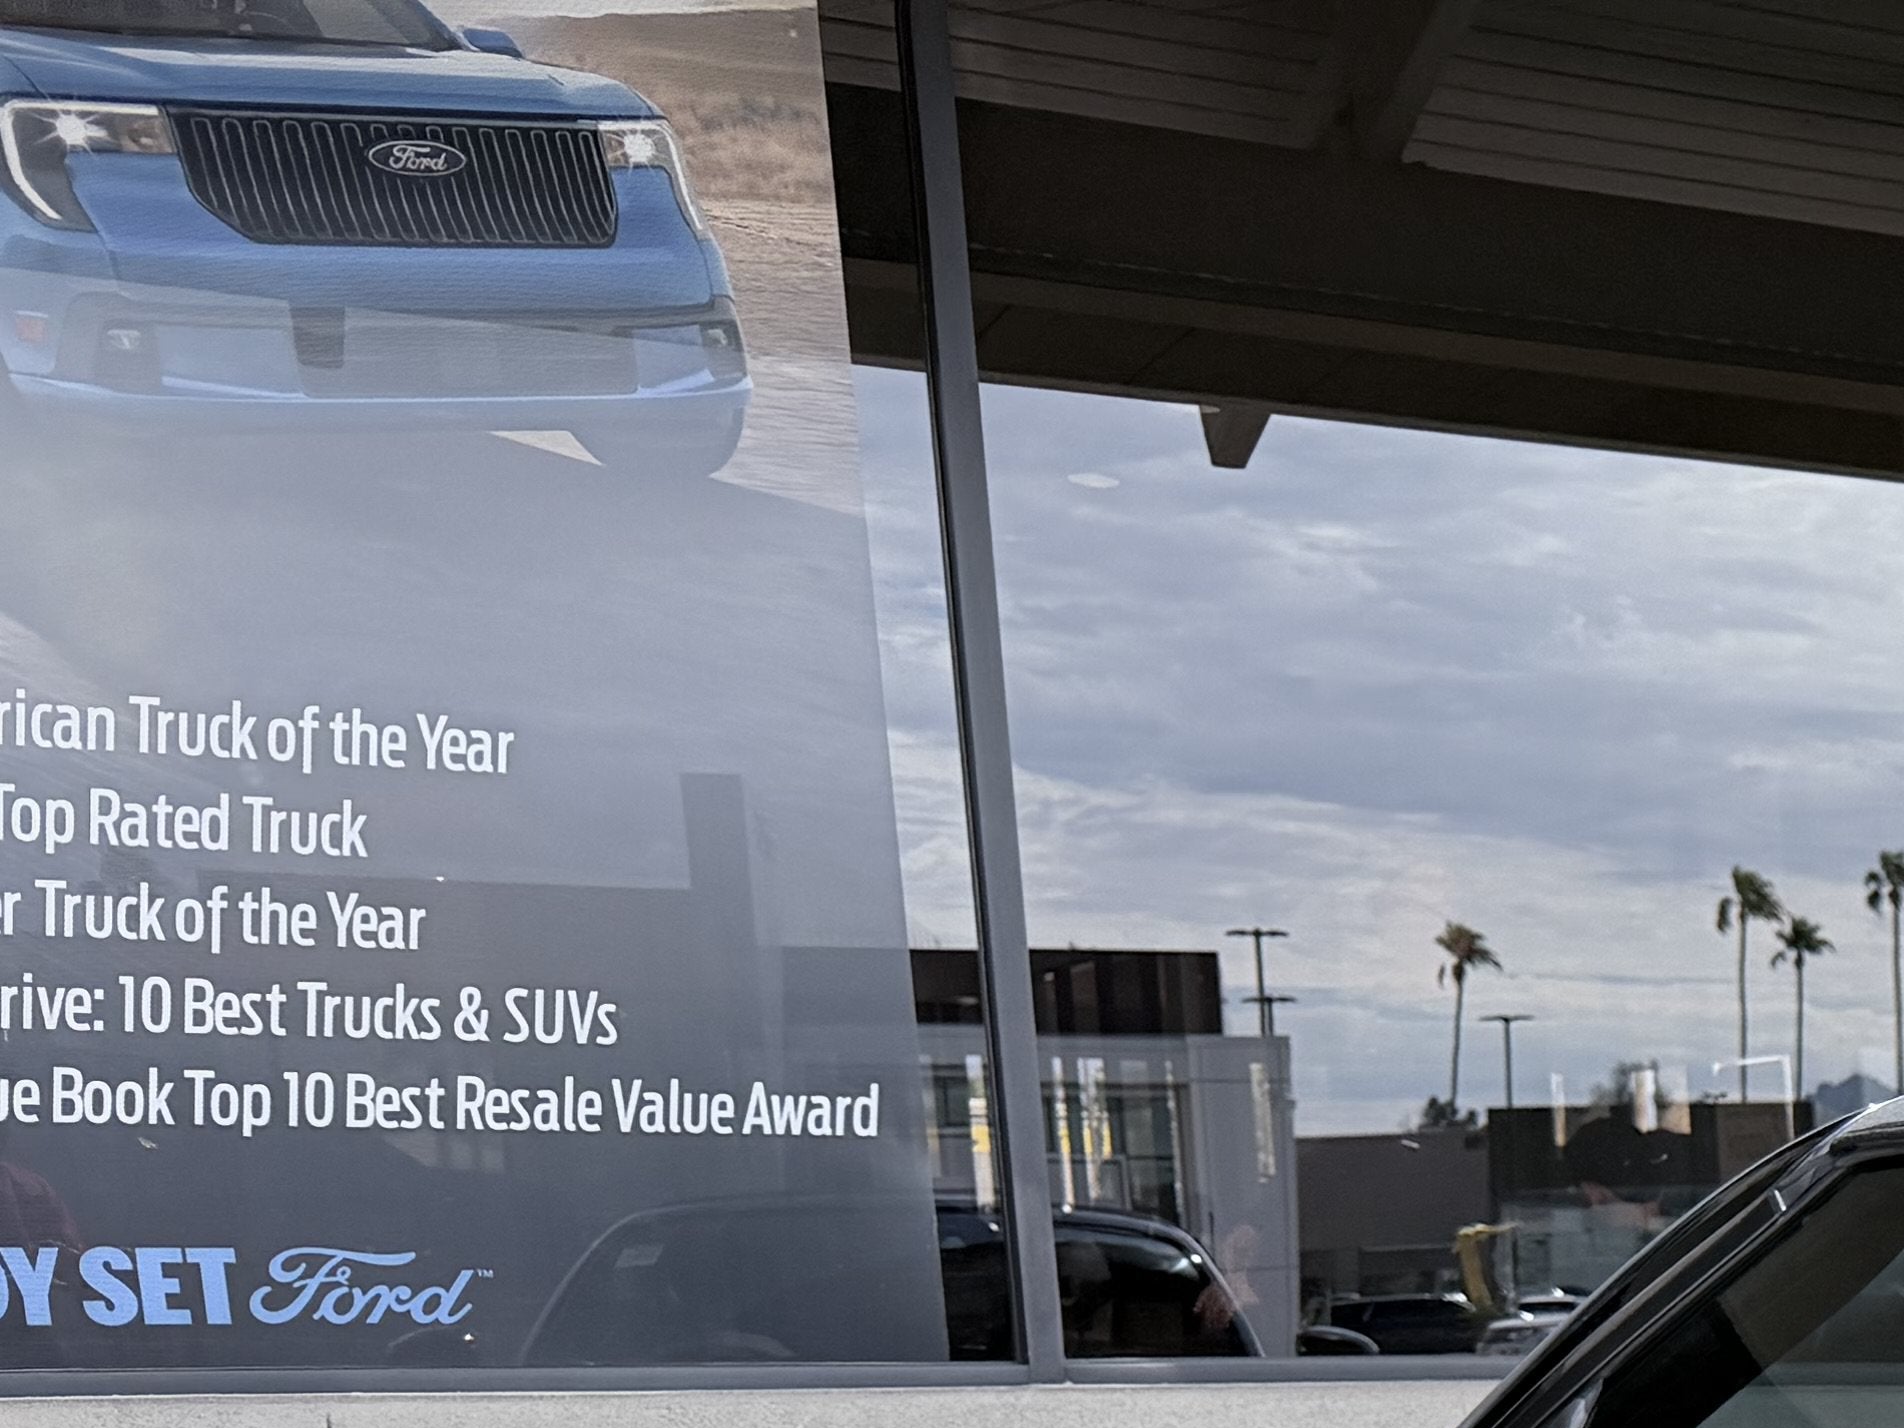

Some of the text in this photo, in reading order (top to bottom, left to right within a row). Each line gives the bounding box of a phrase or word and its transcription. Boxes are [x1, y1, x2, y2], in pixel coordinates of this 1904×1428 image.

[388, 144, 448, 171] Ford
[129, 696, 257, 759] Truck
[268, 706, 319, 774] of
[329, 708, 406, 767] the
[416, 713, 514, 773] Year
[90, 788, 229, 850] Rated
[242, 796, 368, 857] Truck
[35, 879, 165, 940] Truck
[176, 886, 228, 954] of
[239, 887, 317, 946] the
[327, 891, 426, 949] Year
[1, 973, 617, 1045] rive: 10 Best Trucks & SUVs
[53, 1067, 175, 1124] Book
[184, 1070, 271, 1137] Top
[283, 1072, 334, 1127] 10
[346, 1073, 445, 1129] Best
[457, 1076, 602, 1131] Resale
[612, 1079, 734, 1134] Value
[742, 1082, 878, 1136] Award
[79, 1246, 237, 1327] SET
